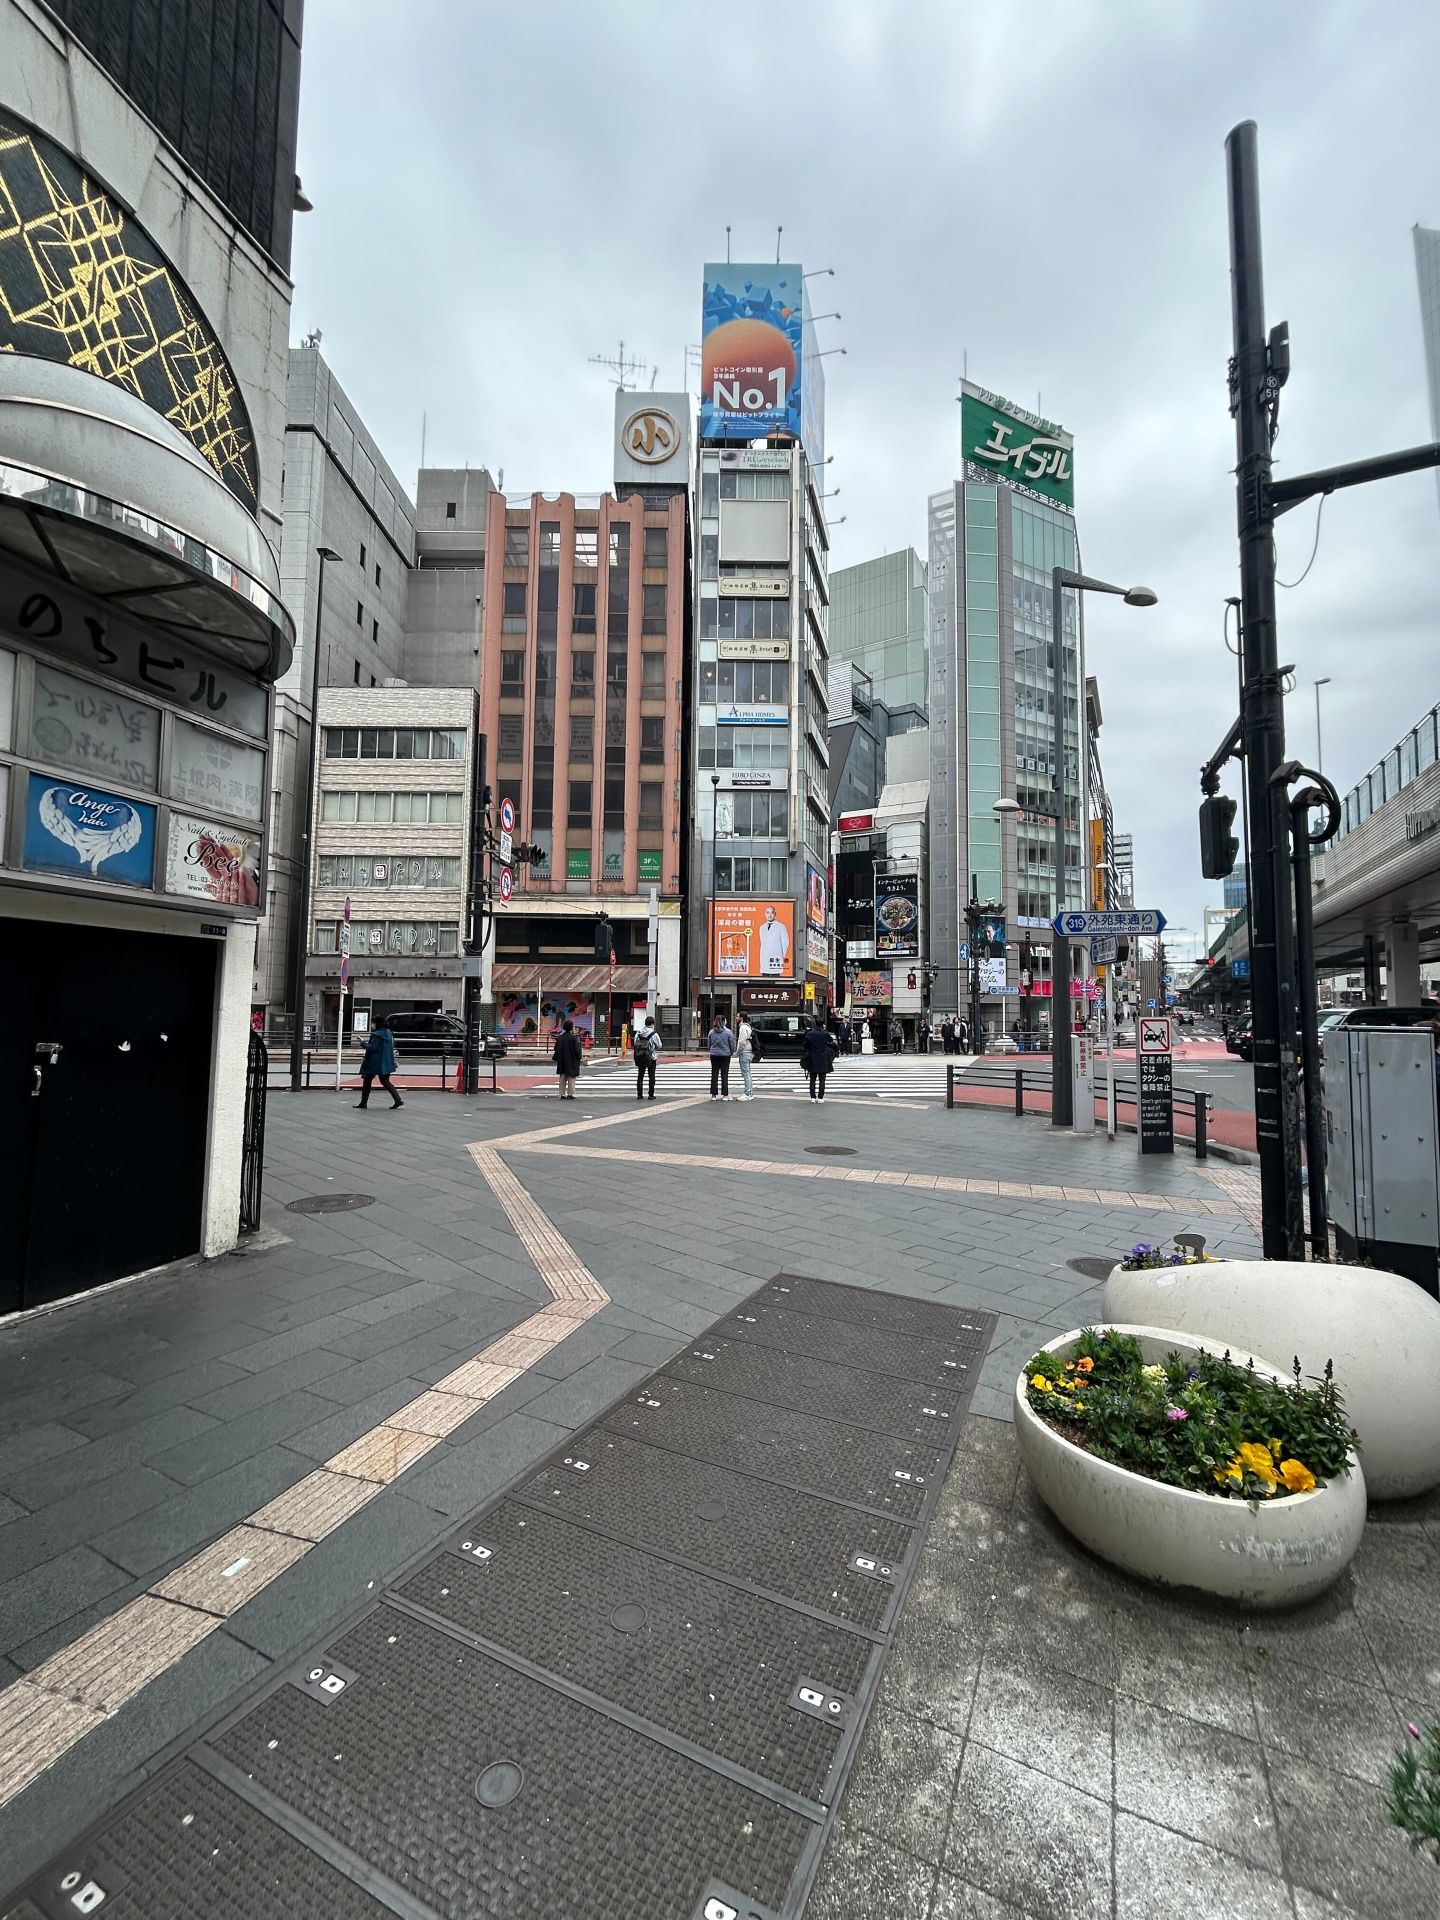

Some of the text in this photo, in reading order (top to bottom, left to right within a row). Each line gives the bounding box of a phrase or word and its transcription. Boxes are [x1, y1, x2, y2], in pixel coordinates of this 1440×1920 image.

[713, 367, 786, 409] No.1
[631, 415, 671, 455] 小
[974, 421, 1072, 480] エイブル
[729, 705, 754, 717] ALPHA
[68, 792, 121, 818] Ange
[78, 810, 108, 827] hair
[181, 823, 248, 847] Nail & Eyelash
[184, 839, 239, 873] Bee
[1069, 919, 1084, 928] 319
[1088, 913, 1153, 925] 外苑東通り
[1141, 1056, 1171, 1064] 交差点内
